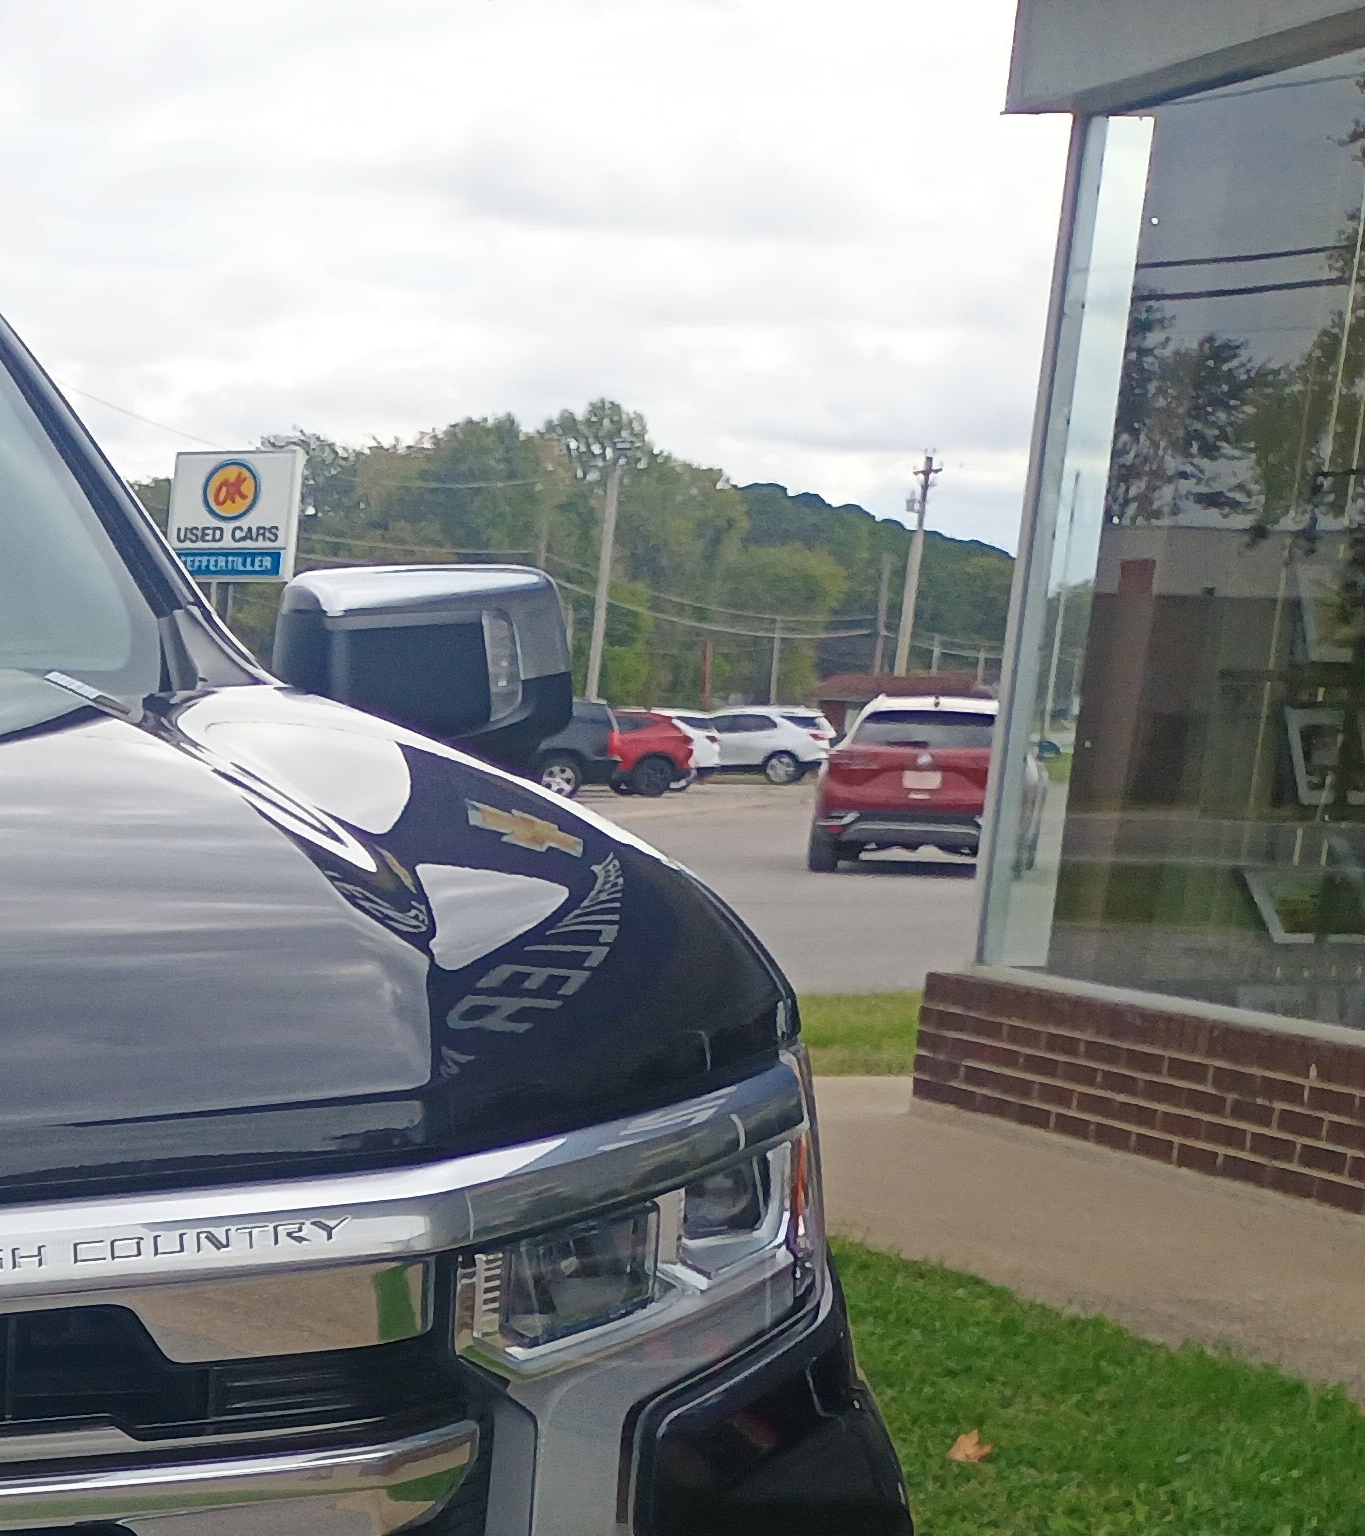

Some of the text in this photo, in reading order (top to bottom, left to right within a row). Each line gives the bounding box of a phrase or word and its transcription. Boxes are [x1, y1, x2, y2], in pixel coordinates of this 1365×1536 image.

[214, 472, 248, 506] OK
[176, 526, 279, 544] USED CARS
[72, 1216, 352, 1265] COUNTRY
